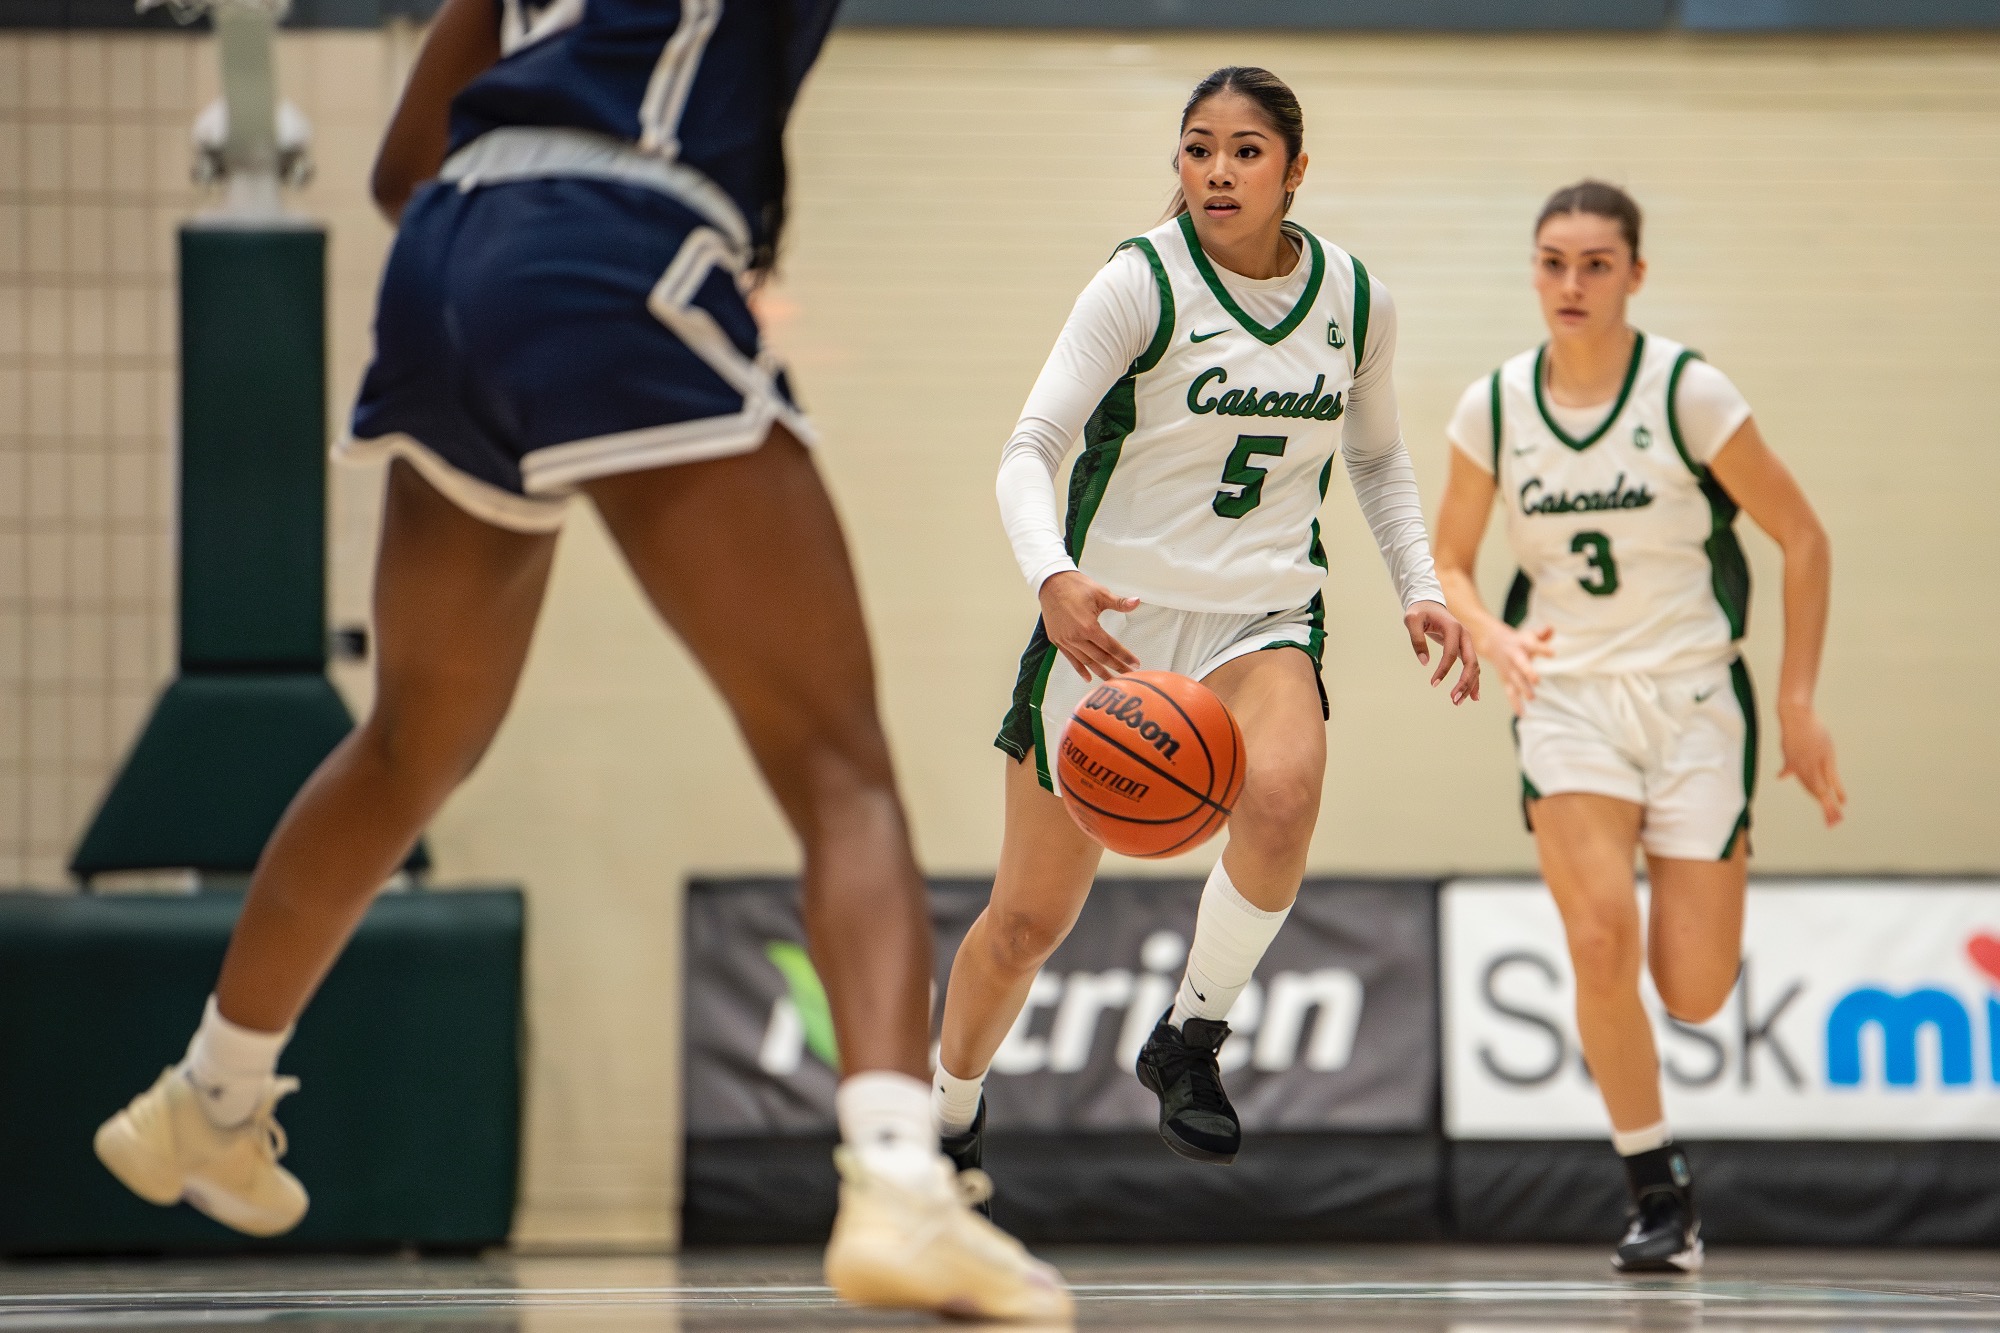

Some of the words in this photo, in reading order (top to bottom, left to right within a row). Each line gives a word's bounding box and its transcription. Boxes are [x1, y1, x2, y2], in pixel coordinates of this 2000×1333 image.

[1187, 366, 1343, 421] Cascades
[1213, 434, 1288, 519] 5
[1520, 470, 1656, 517] Cascades
[1569, 531, 1619, 596] 3
[1085, 685, 1181, 761] Wilson
[1062, 737, 1149, 798] EVOLUTION
